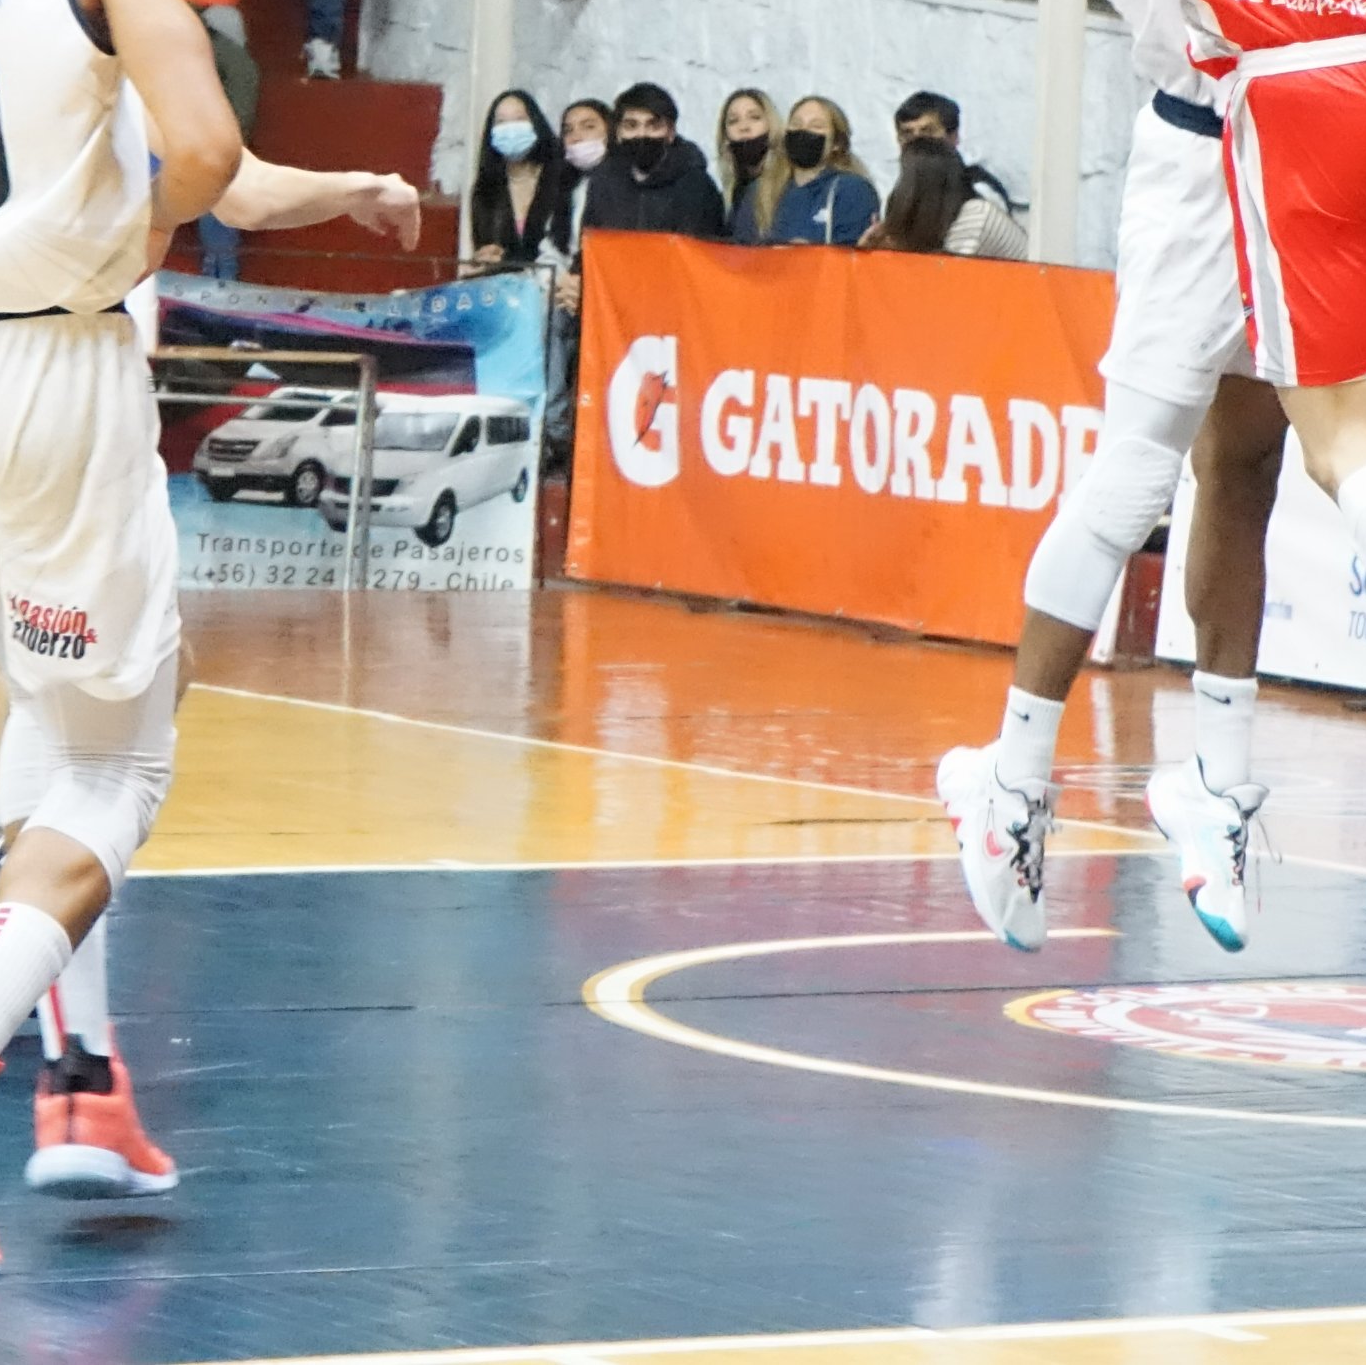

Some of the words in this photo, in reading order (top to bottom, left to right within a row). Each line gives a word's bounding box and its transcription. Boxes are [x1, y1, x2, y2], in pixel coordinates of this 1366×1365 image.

[607, 335, 681, 488] G
[700, 368, 1107, 514] GATORADE
[192, 562, 256, 588] (+56)
[266, 564, 295, 586] 32
[305, 566, 421, 591] 24279
[196, 532, 344, 559] Transporte
[392, 539, 526, 566] Pasajeros
